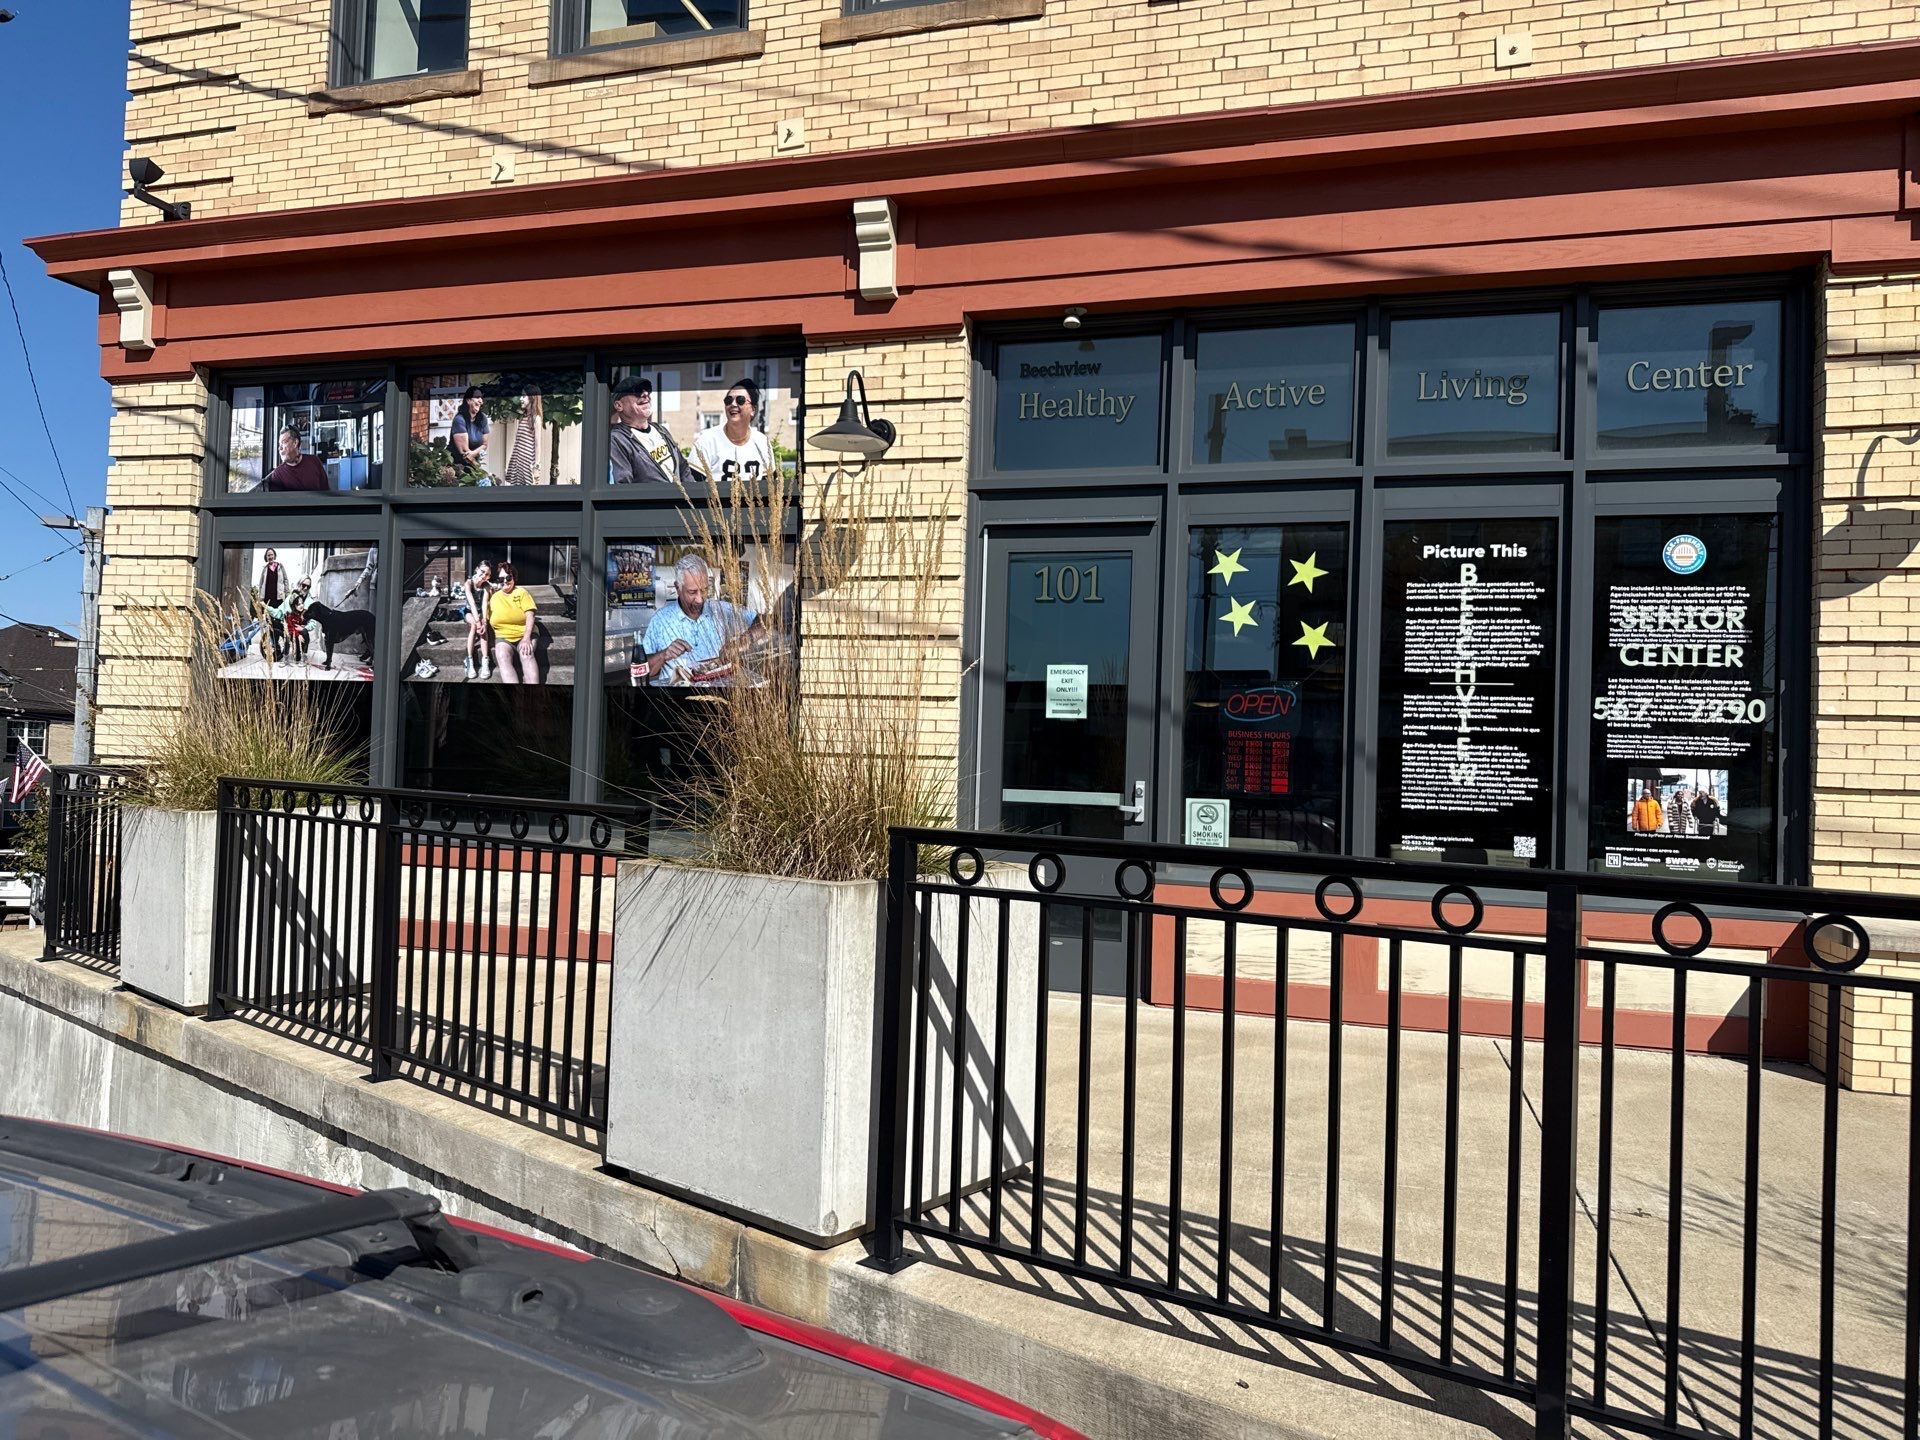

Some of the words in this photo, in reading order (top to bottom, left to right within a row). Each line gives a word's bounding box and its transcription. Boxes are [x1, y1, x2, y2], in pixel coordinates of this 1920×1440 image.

[1020, 361, 1101, 378] Beechview
[1019, 388, 1136, 423] Healthy
[1220, 379, 1326, 411] Active
[1418, 369, 1529, 405] Living
[1627, 361, 1753, 392] Center
[1423, 544, 1486, 558] Picture
[1490, 543, 1527, 557] This
[1035, 565, 1104, 601] 101
[1619, 607, 1746, 630] SENIOR
[1619, 644, 1744, 668] CENTER
[1227, 694, 1292, 715] OPEN
[1228, 730, 1262, 739] BUSINESS
[1264, 731, 1291, 740] HOURS
[1192, 831, 1223, 839] SMOKING
[1665, 857, 1700, 866] SWPPA
